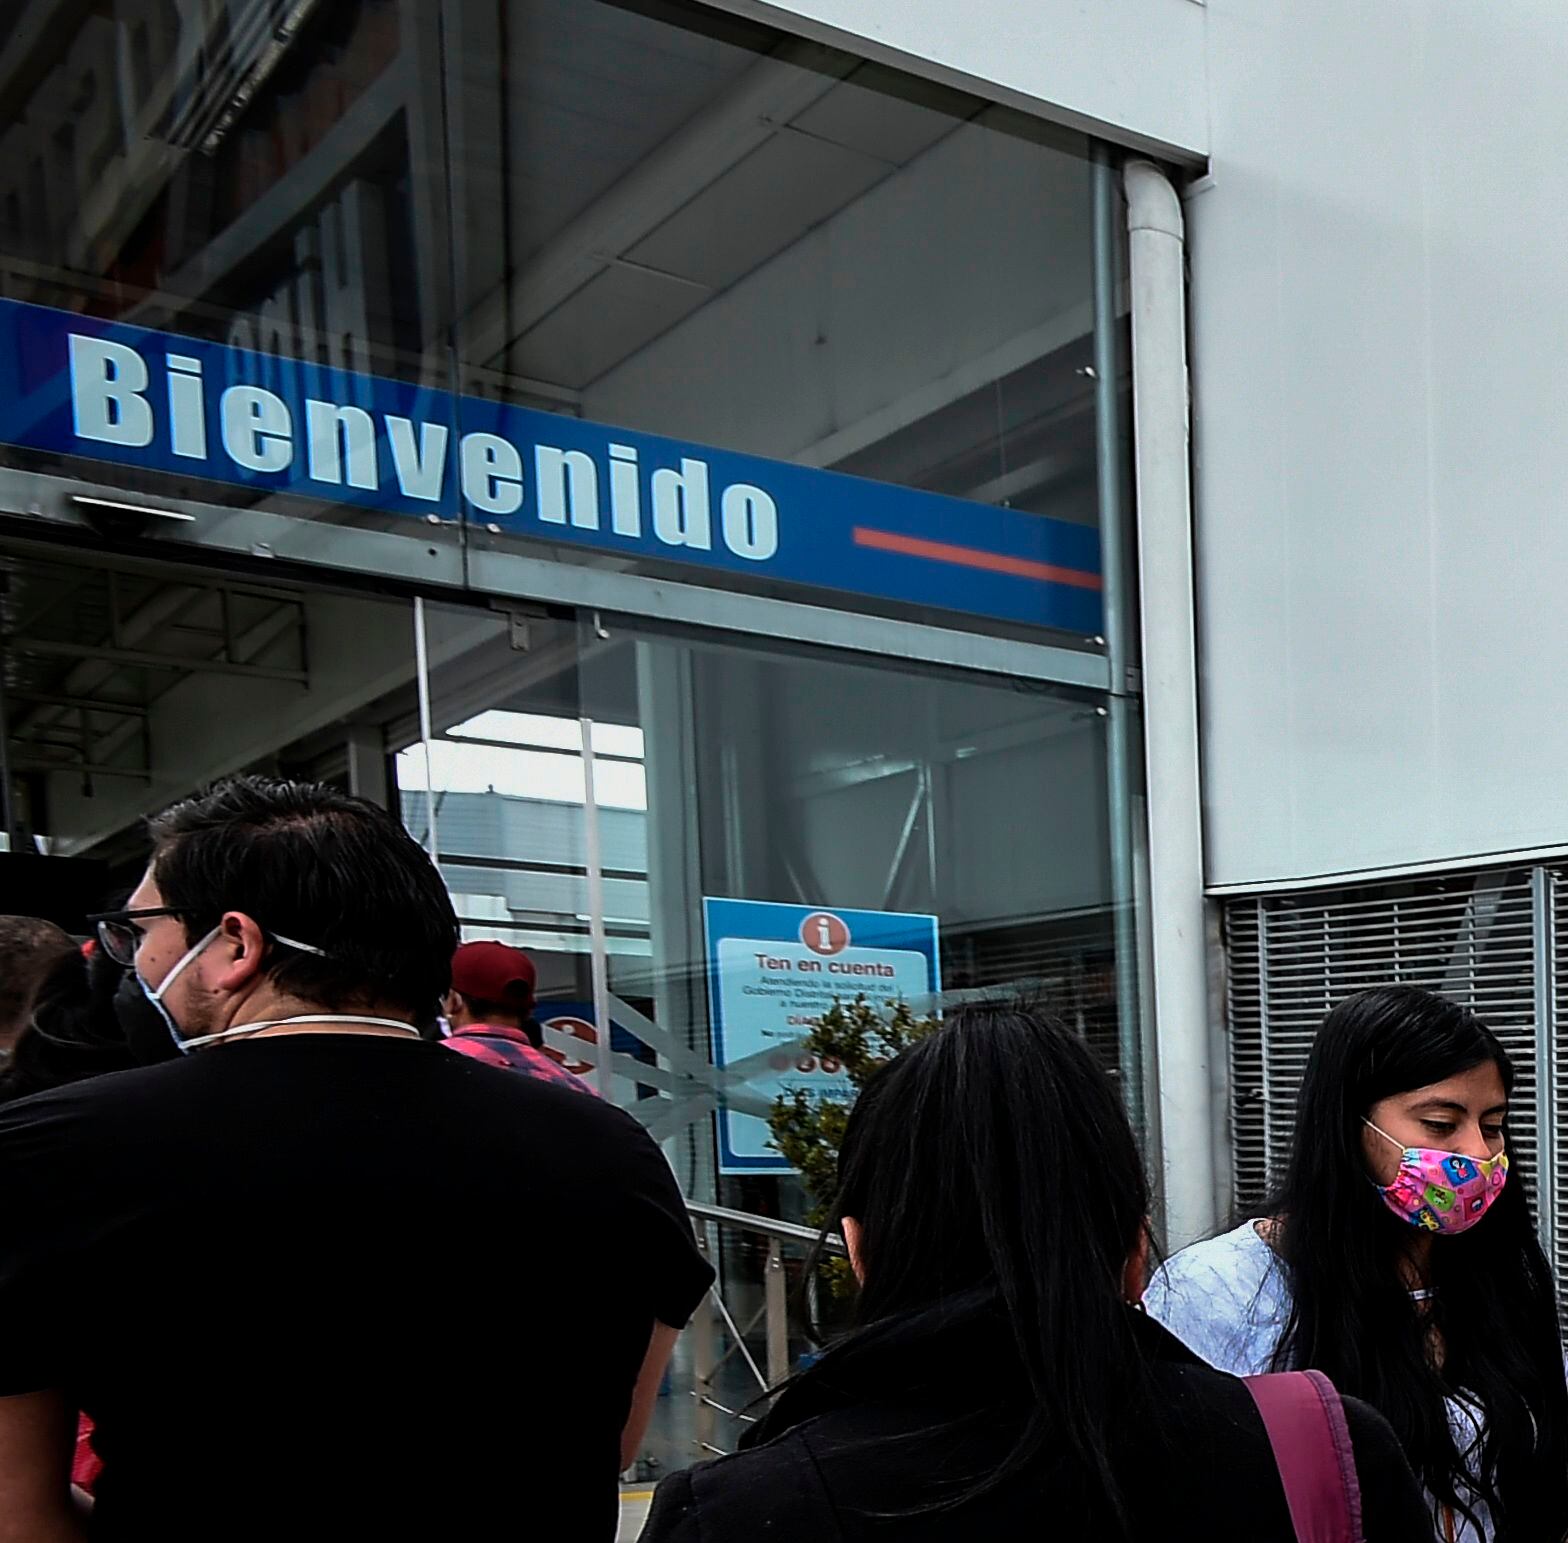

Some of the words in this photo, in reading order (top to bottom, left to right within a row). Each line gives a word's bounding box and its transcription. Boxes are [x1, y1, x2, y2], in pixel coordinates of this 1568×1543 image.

[67, 333, 780, 561] Bienvenido
[754, 953, 791, 970] Ten
[798, 959, 821, 972] en
[829, 960, 894, 977] cuenta
